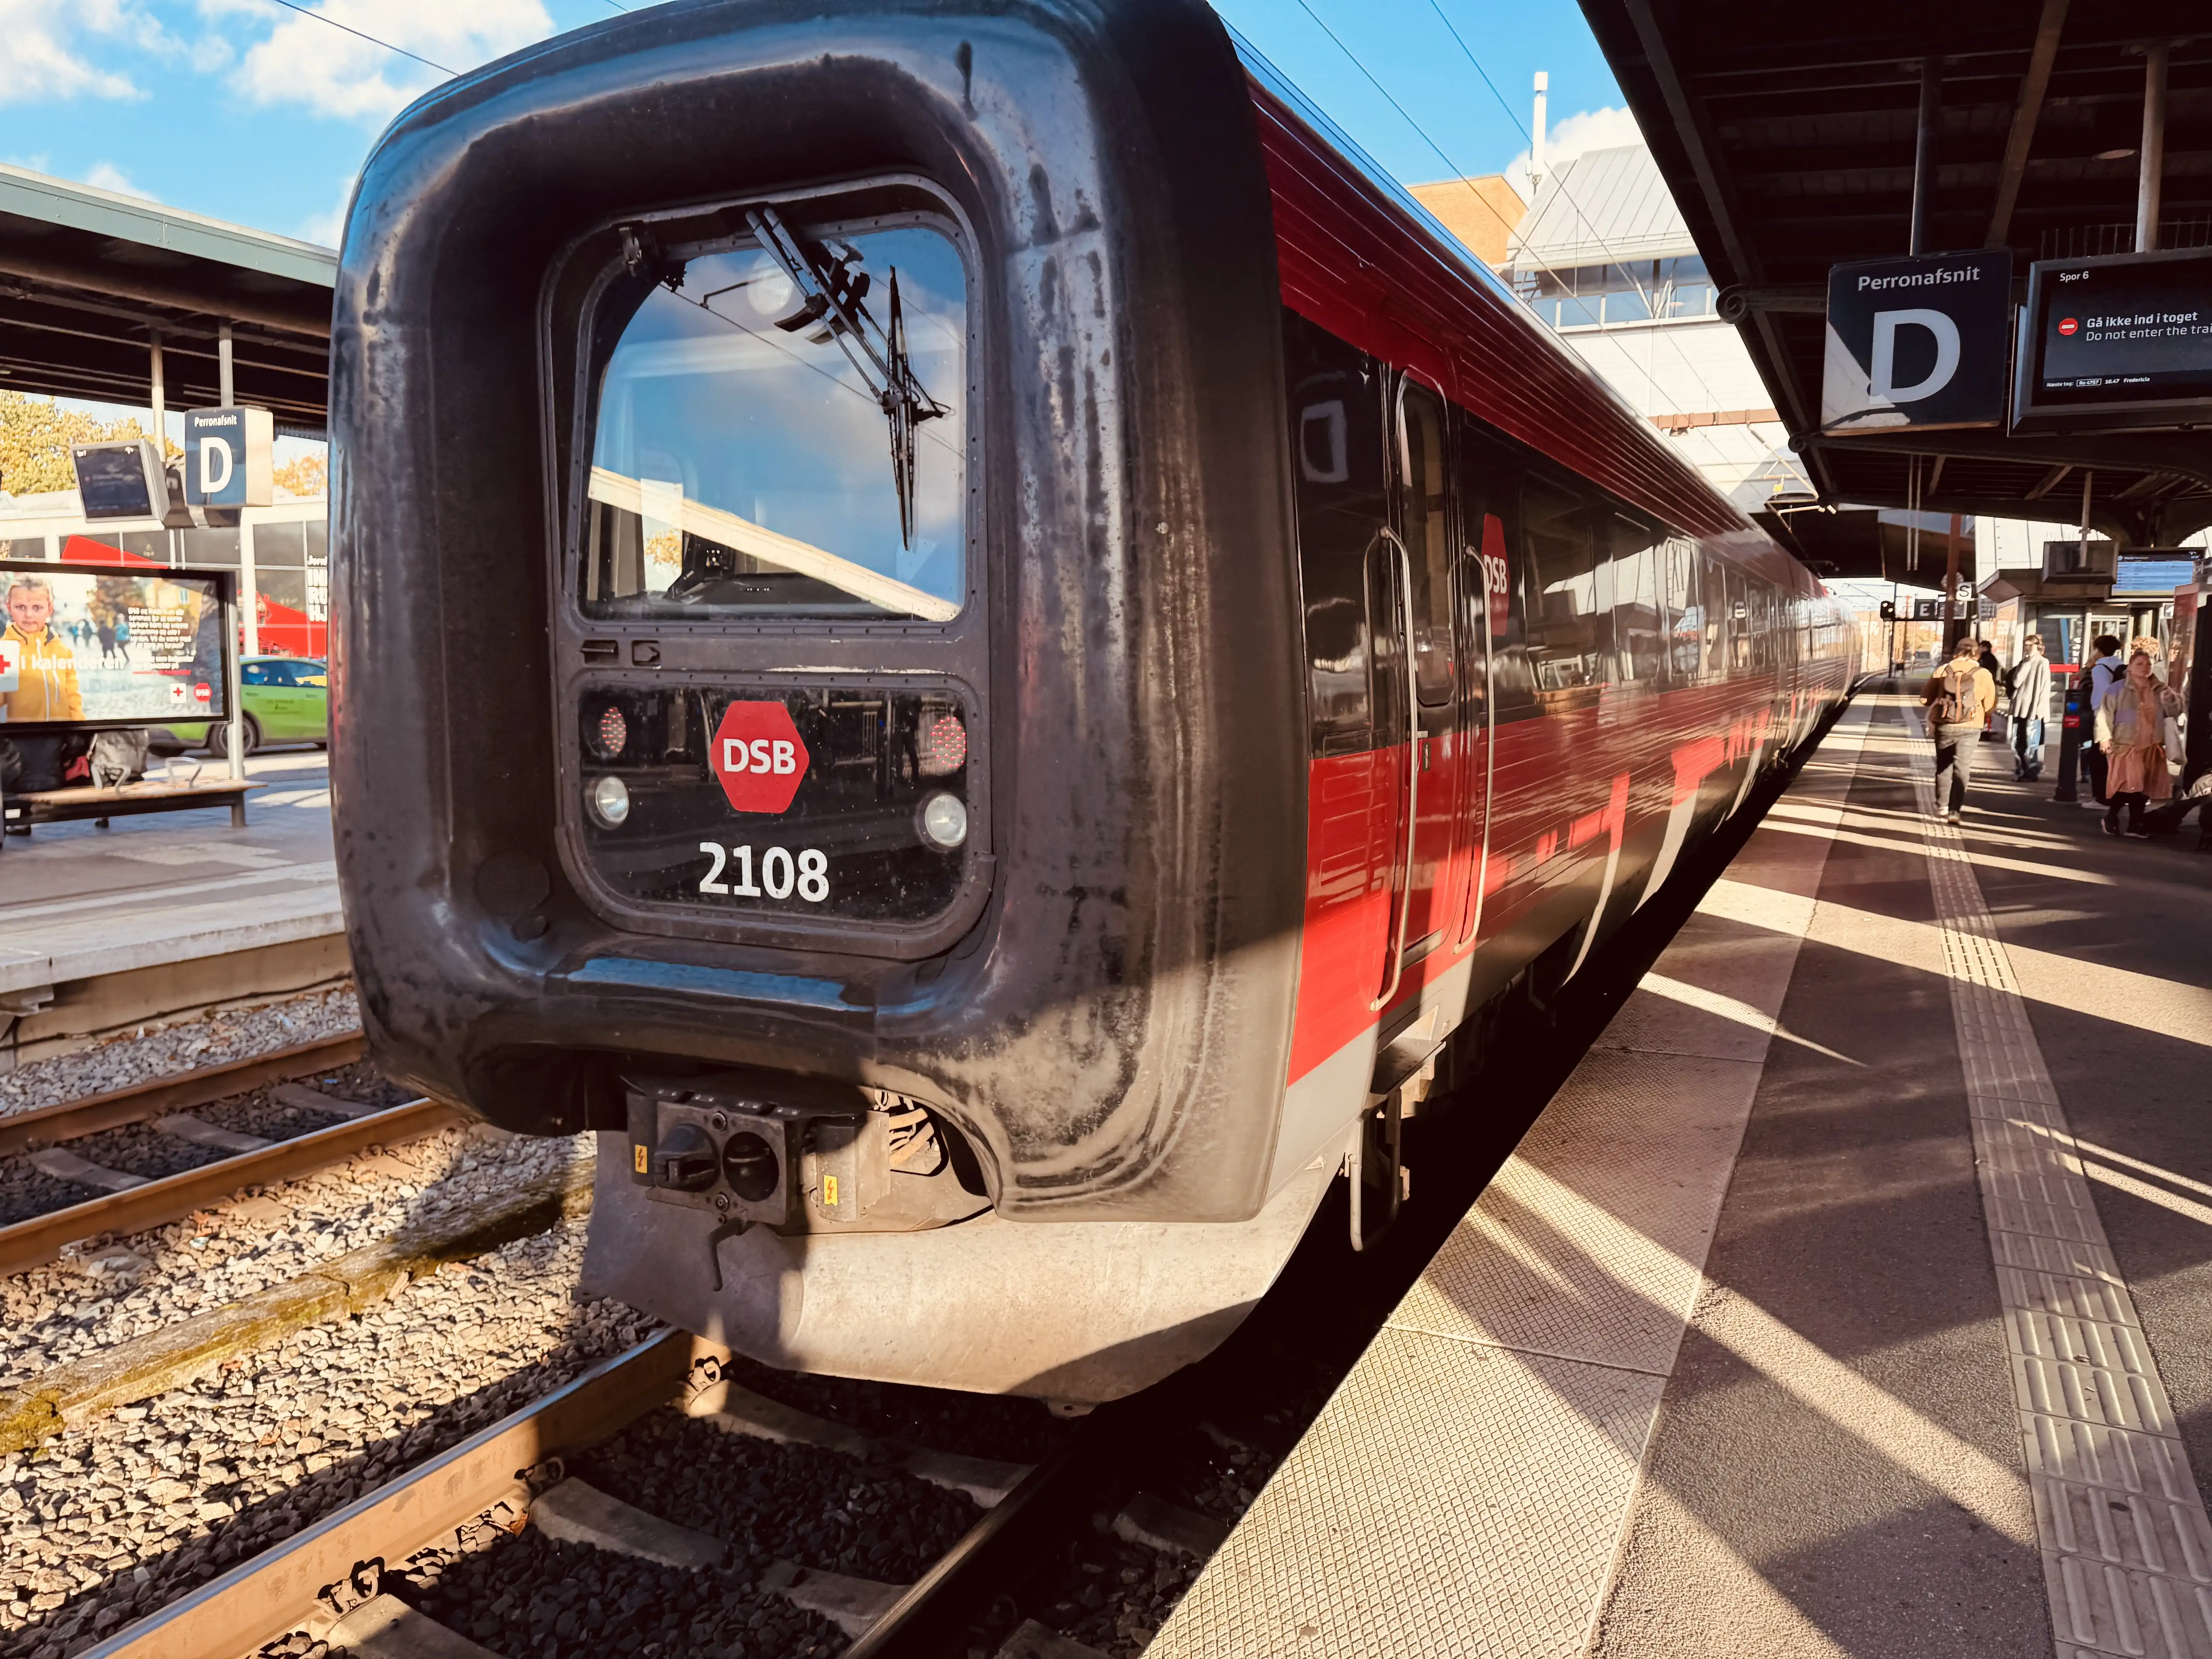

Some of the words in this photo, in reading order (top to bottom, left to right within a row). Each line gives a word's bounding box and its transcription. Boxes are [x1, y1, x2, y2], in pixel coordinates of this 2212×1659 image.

[1858, 266, 1980, 291] Perronafsnit
[2059, 273, 2081, 283] Spor
[2083, 271, 2089, 279] 6
[2087, 317, 2103, 328] Gå
[2106, 316, 2131, 326] ikke
[2134, 314, 2154, 325] ind
[2156, 313, 2160, 323] i
[2163, 312, 2198, 324] toget
[2086, 331, 2102, 341] Do
[2105, 330, 2126, 340] not
[2130, 328, 2164, 338] enter
[2166, 326, 2187, 336] the
[1870, 308, 1960, 405] D
[194, 414, 237, 427] Perronafsnit
[200, 436, 234, 493] D
[1484, 554, 1507, 594] DSB
[1959, 585, 1970, 597] S
[1920, 603, 1930, 617] E
[31, 654, 125, 670] kalenderen
[723, 738, 795, 775] DSB
[699, 842, 830, 902] 2108
